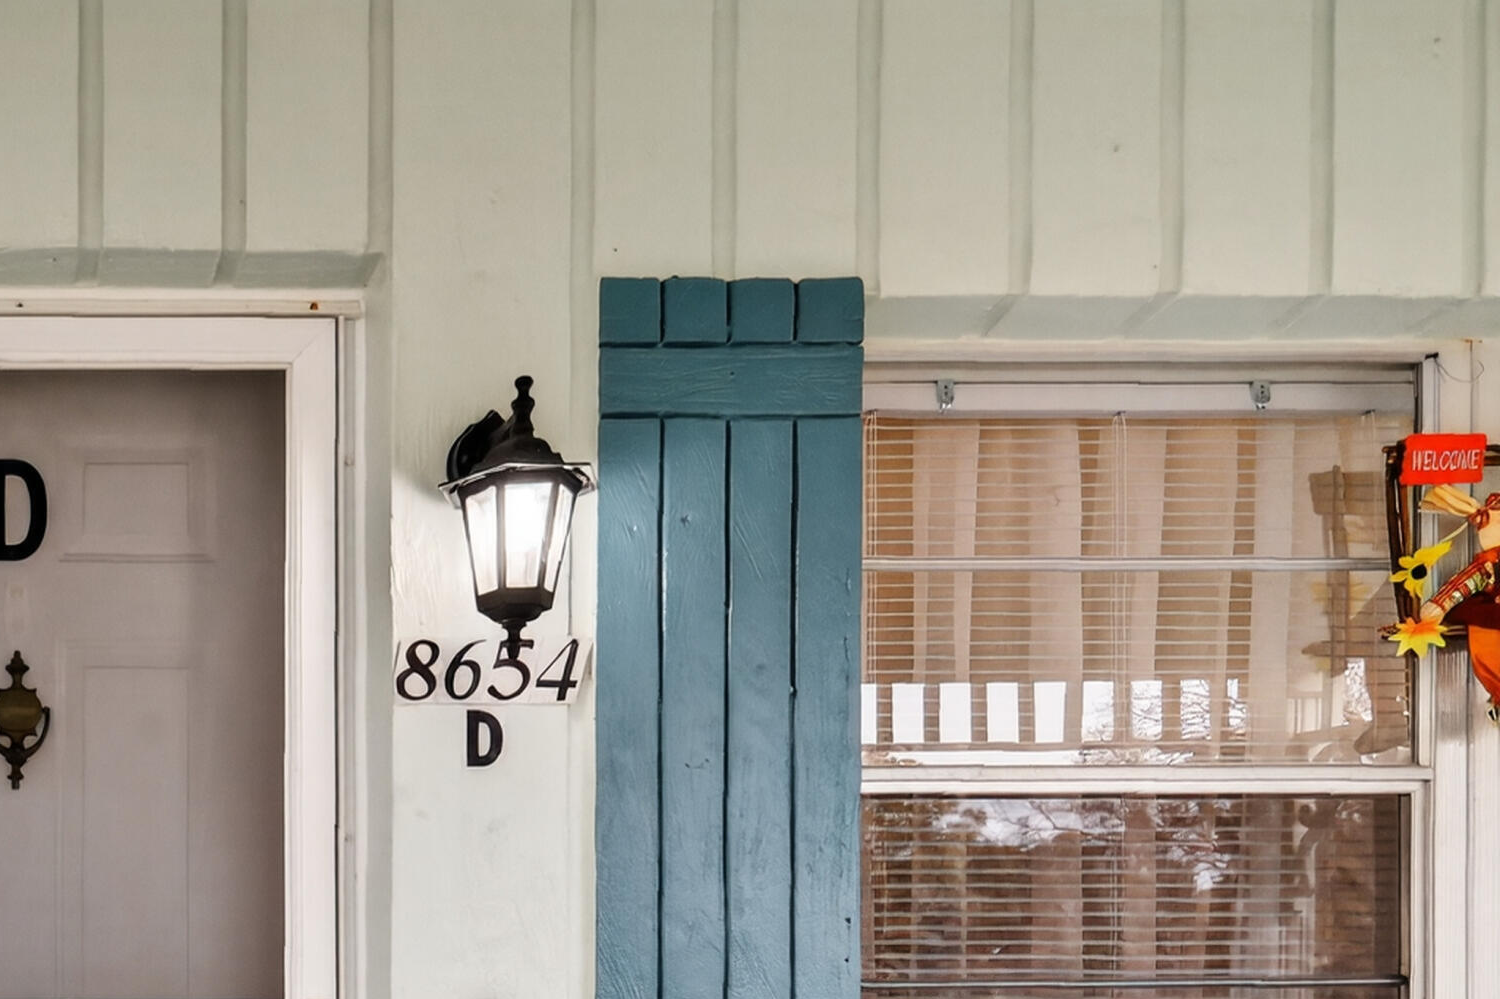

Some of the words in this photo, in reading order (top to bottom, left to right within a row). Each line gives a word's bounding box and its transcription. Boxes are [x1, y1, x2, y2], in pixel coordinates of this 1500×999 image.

[1412, 449, 1480, 471] WELCOME
[396, 638, 579, 701] 8654
[466, 709, 503, 767] D
